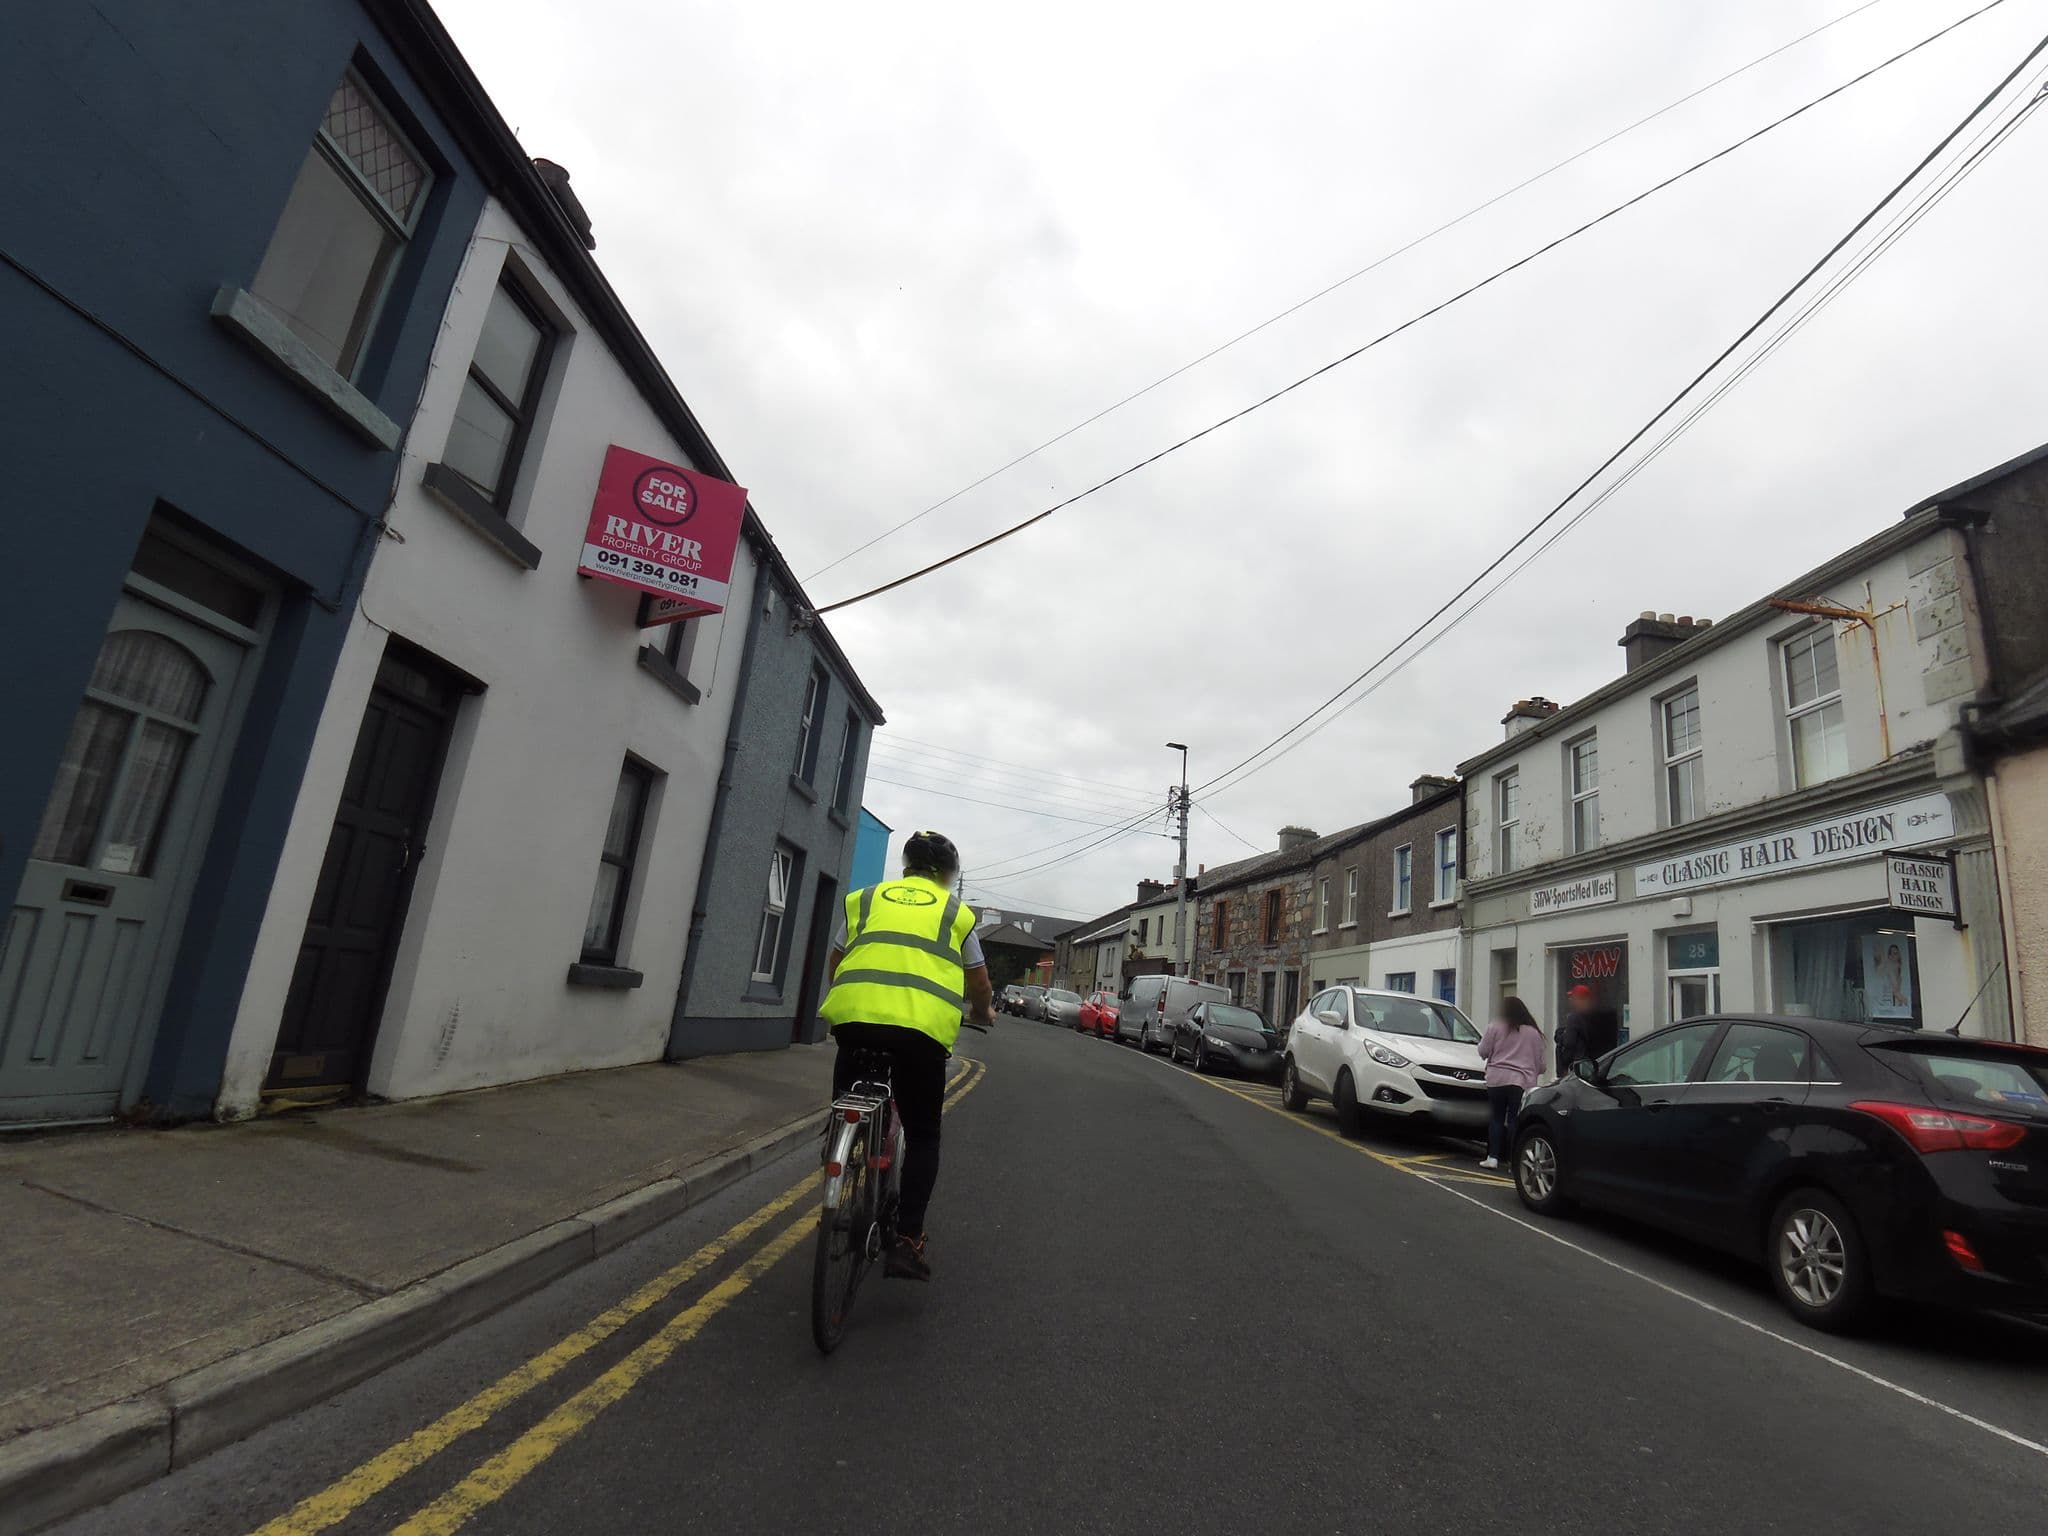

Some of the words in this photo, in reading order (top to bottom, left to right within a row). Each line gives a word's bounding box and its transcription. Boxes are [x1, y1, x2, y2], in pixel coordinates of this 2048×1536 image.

[648, 477, 687, 499] FOR
[641, 490, 687, 514] SALE
[604, 514, 702, 562] RIVER
[601, 534, 659, 559] PROPERTY
[661, 552, 702, 571] GROUP
[595, 562, 696, 596] www.riverpropertygroup.ie
[597, 551, 628, 570] 091
[632, 560, 665, 580] 394
[669, 571, 698, 589] 081
[660, 598, 676, 610] 091
[1662, 851, 1729, 886] CLASSIC
[1739, 837, 1799, 871] HAIR
[1811, 812, 1897, 856] DESIGN
[1893, 860, 1944, 879] CLASSIC
[1901, 879, 1938, 894] HAIR
[1900, 892, 1943, 909] DESIGN
[1572, 946, 1621, 978] SMW
[1688, 943, 1706, 959] 28
